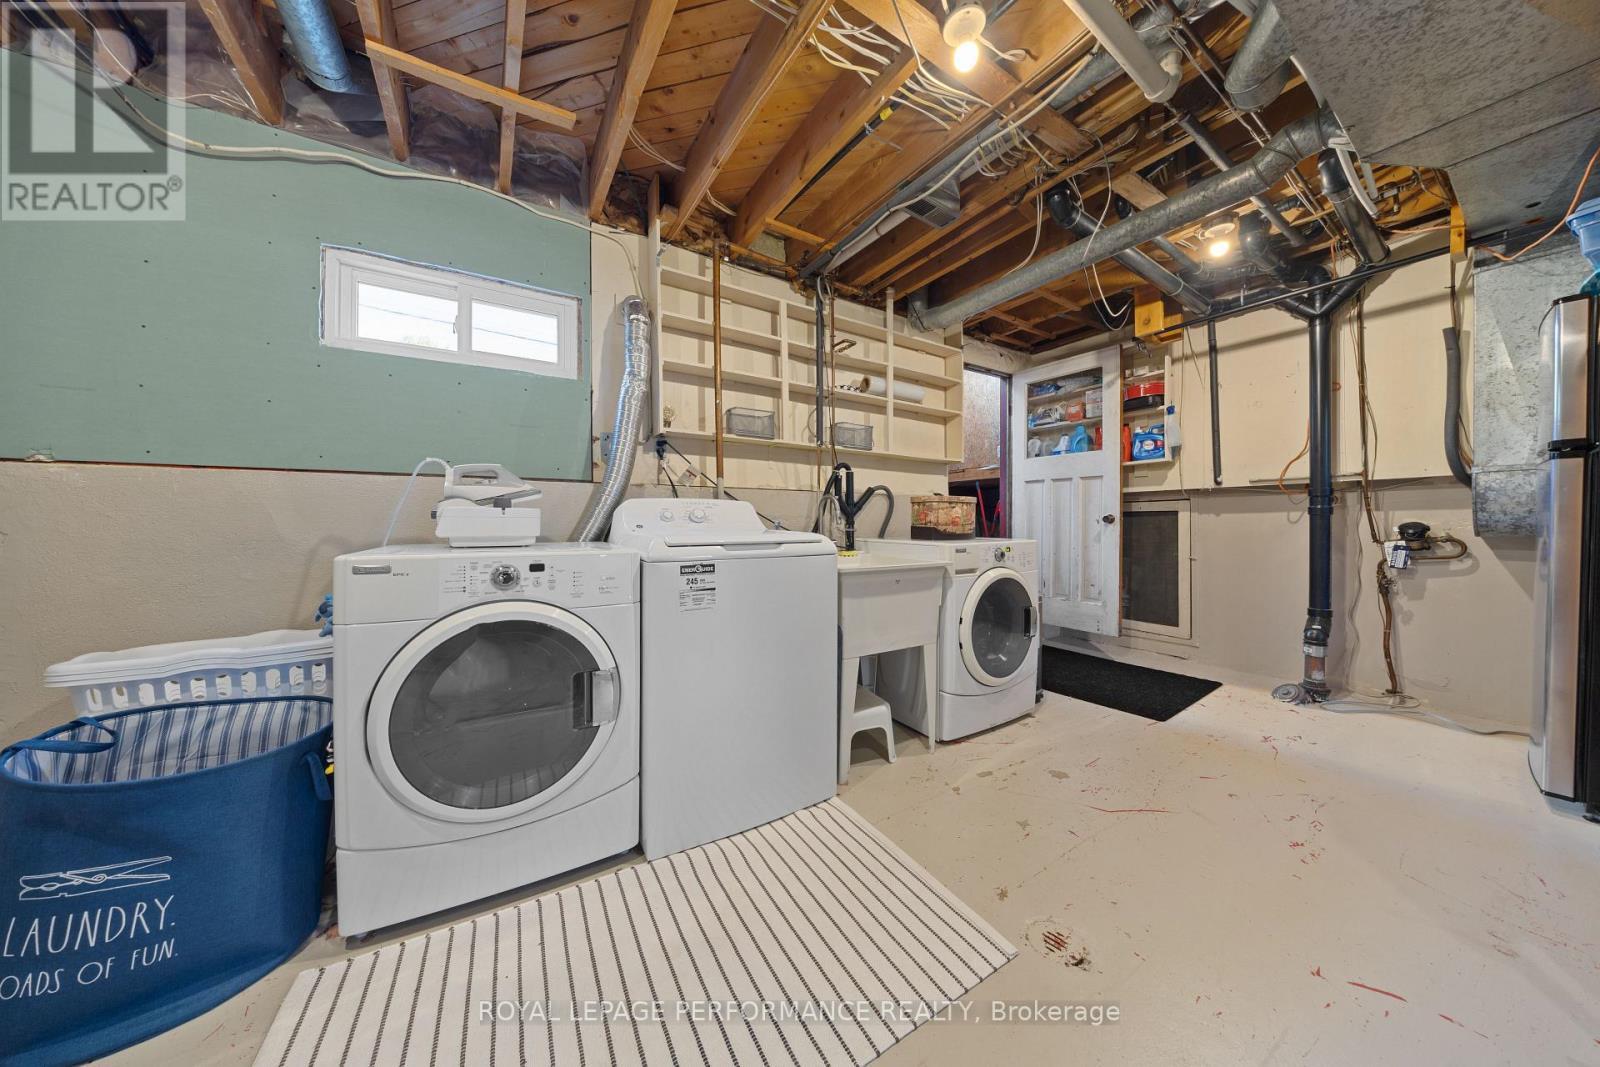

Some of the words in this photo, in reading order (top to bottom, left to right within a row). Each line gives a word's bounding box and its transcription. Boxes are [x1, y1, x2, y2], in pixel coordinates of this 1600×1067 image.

[686, 577, 699, 586] 245
[3, 894, 176, 958] LAUNDRY.
[77, 956, 116, 985] OF
[130, 938, 179, 970] FUN.
